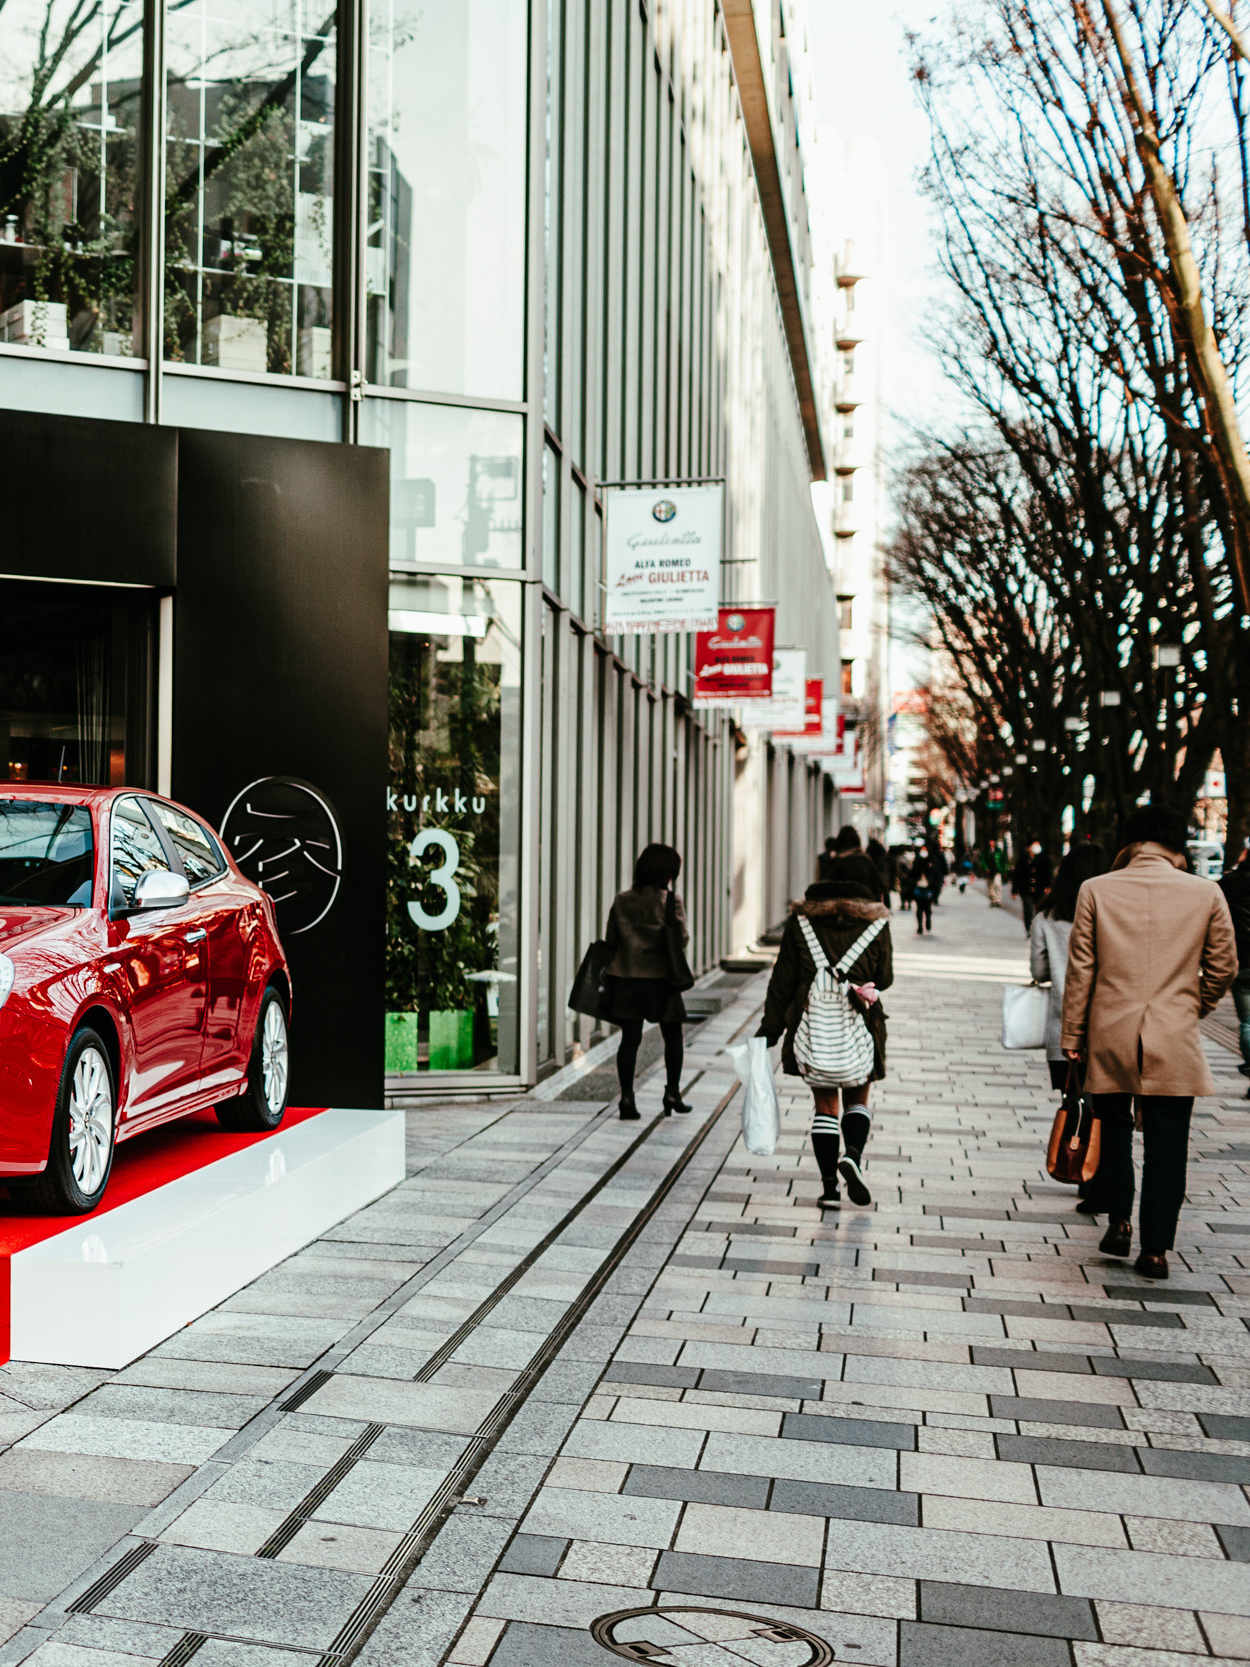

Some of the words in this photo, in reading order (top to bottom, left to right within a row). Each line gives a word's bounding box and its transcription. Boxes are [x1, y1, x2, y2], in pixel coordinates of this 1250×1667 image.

[634, 559, 656, 570] ALFA
[658, 557, 692, 568] ROMEO
[648, 569, 710, 585] GIULIETTA
[386, 785, 486, 814] kurkku
[407, 827, 461, 932] 3
